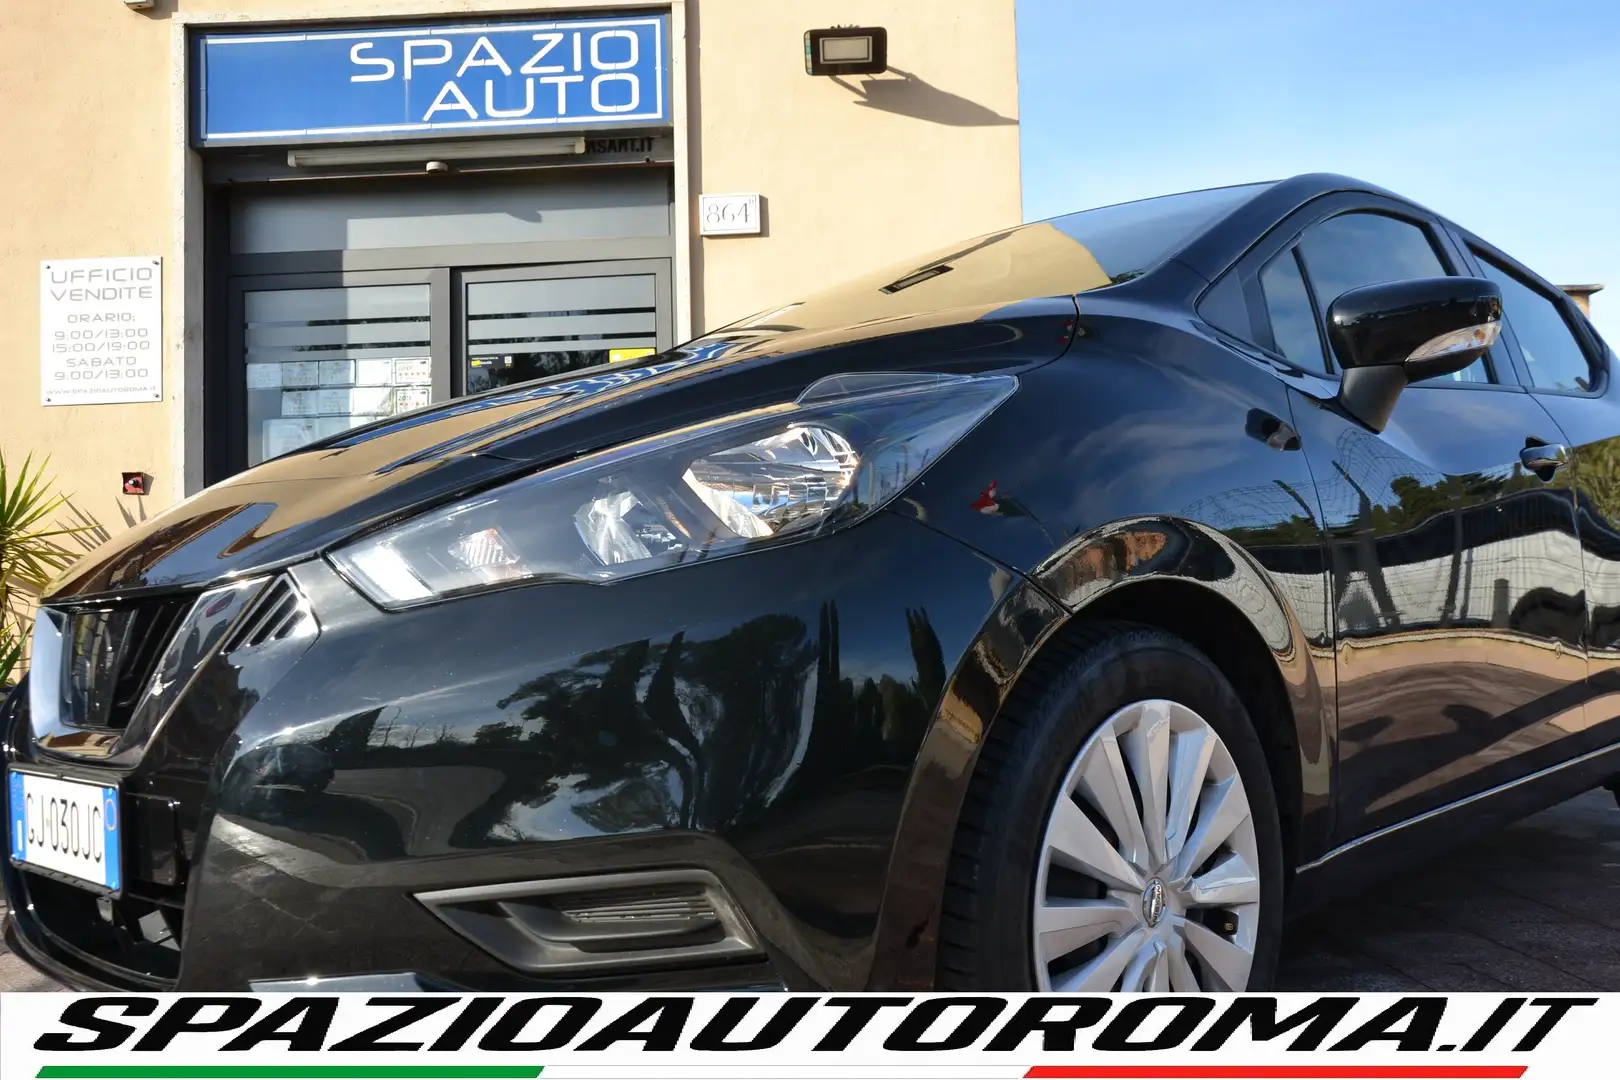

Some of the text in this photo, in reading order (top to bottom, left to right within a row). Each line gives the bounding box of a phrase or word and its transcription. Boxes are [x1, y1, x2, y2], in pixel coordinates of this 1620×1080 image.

[350, 30, 639, 82] SPAZIO
[423, 73, 639, 121] AUTO
[51, 268, 152, 283] UFFICIO
[51, 286, 153, 301] VENDITE
[54, 328, 148, 340] 9:00/13:00
[52, 340, 150, 353] 15:00/19:00
[66, 356, 136, 367] SABATO
[54, 368, 148, 380] 9:00/13:00
